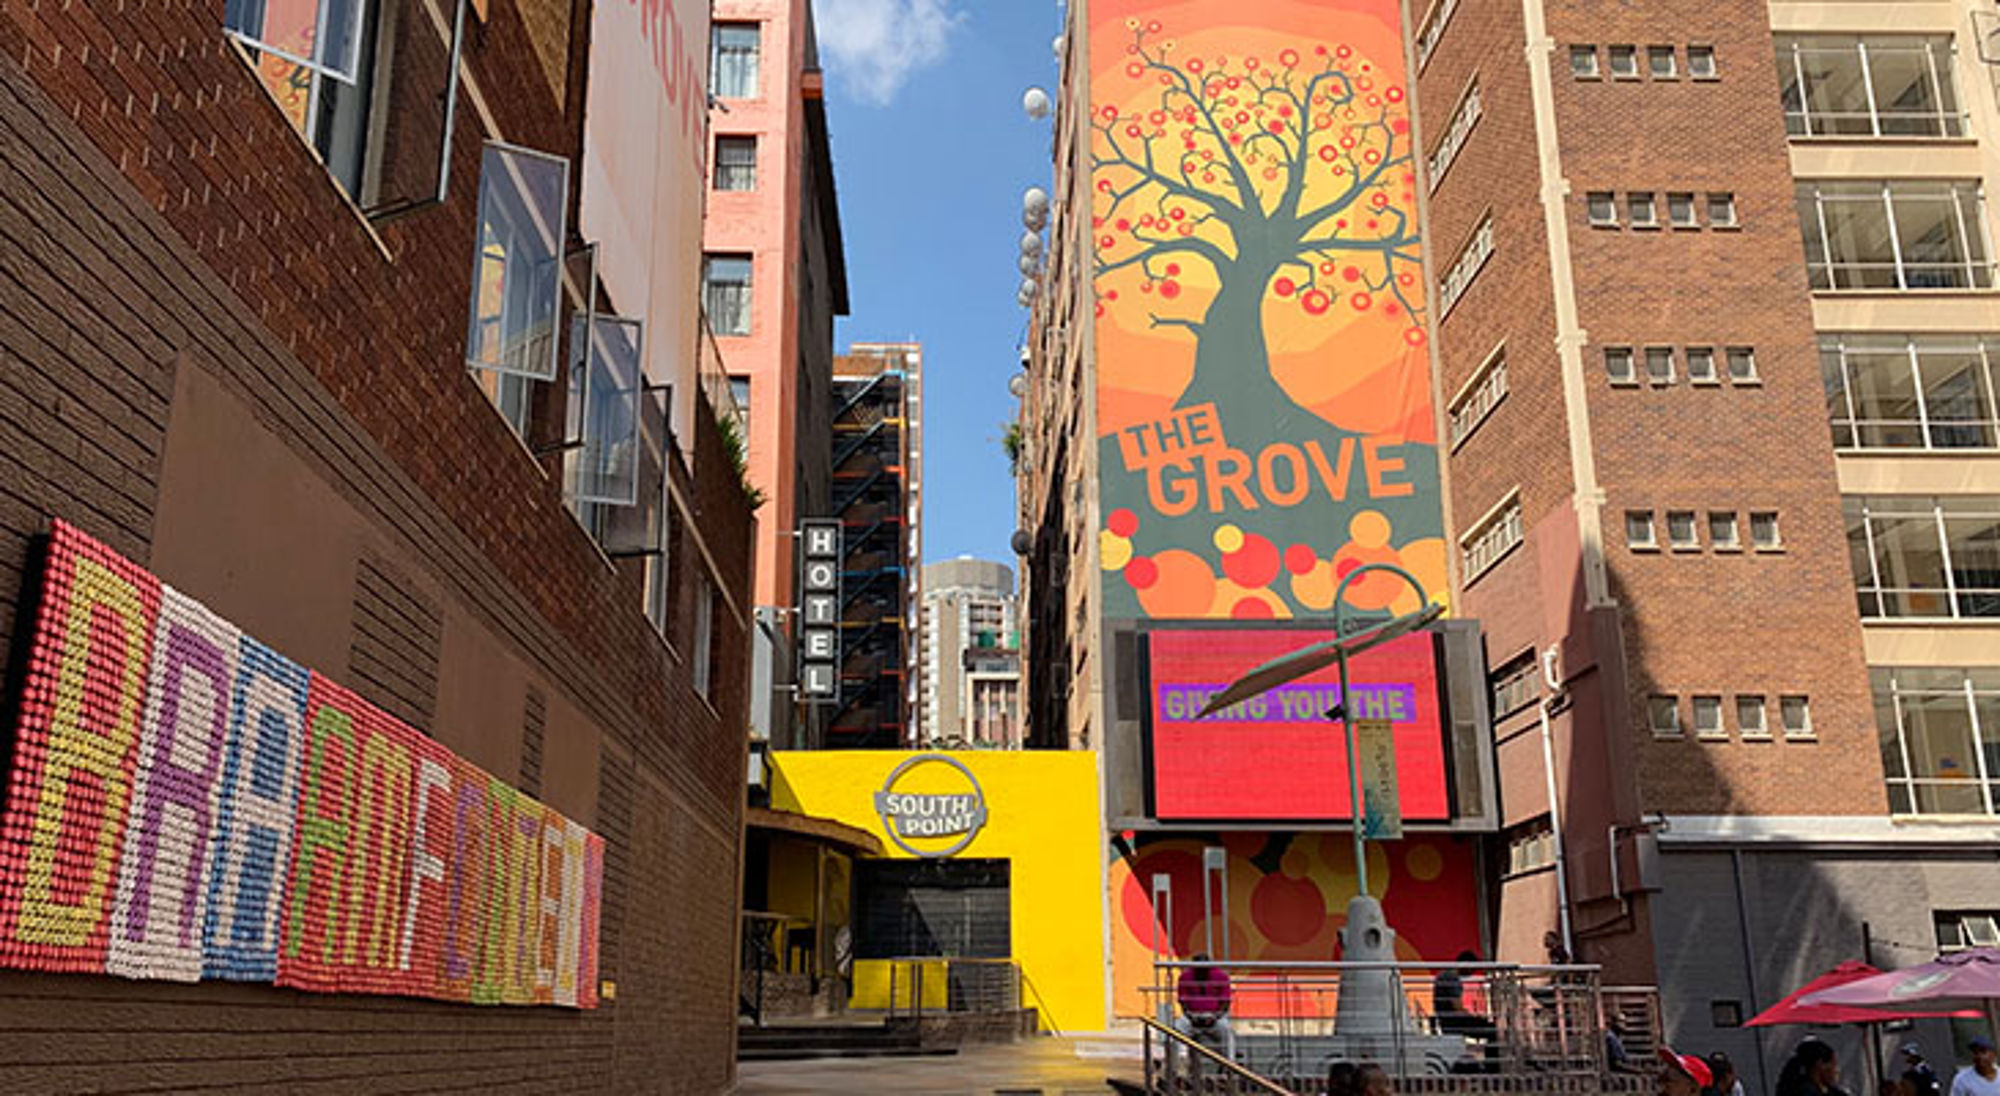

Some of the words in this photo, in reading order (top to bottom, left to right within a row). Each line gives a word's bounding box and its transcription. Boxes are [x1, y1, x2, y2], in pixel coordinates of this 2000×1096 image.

[628, 0, 705, 177] ROVE
[1124, 411, 1212, 455] THE
[1147, 437, 1414, 516] GROVE
[808, 530, 833, 691] HOTEL
[1277, 689, 1336, 720] YOU
[1349, 689, 1406, 720] THE
[886, 794, 969, 816] SOUTH
[906, 812, 976, 835] POINT
